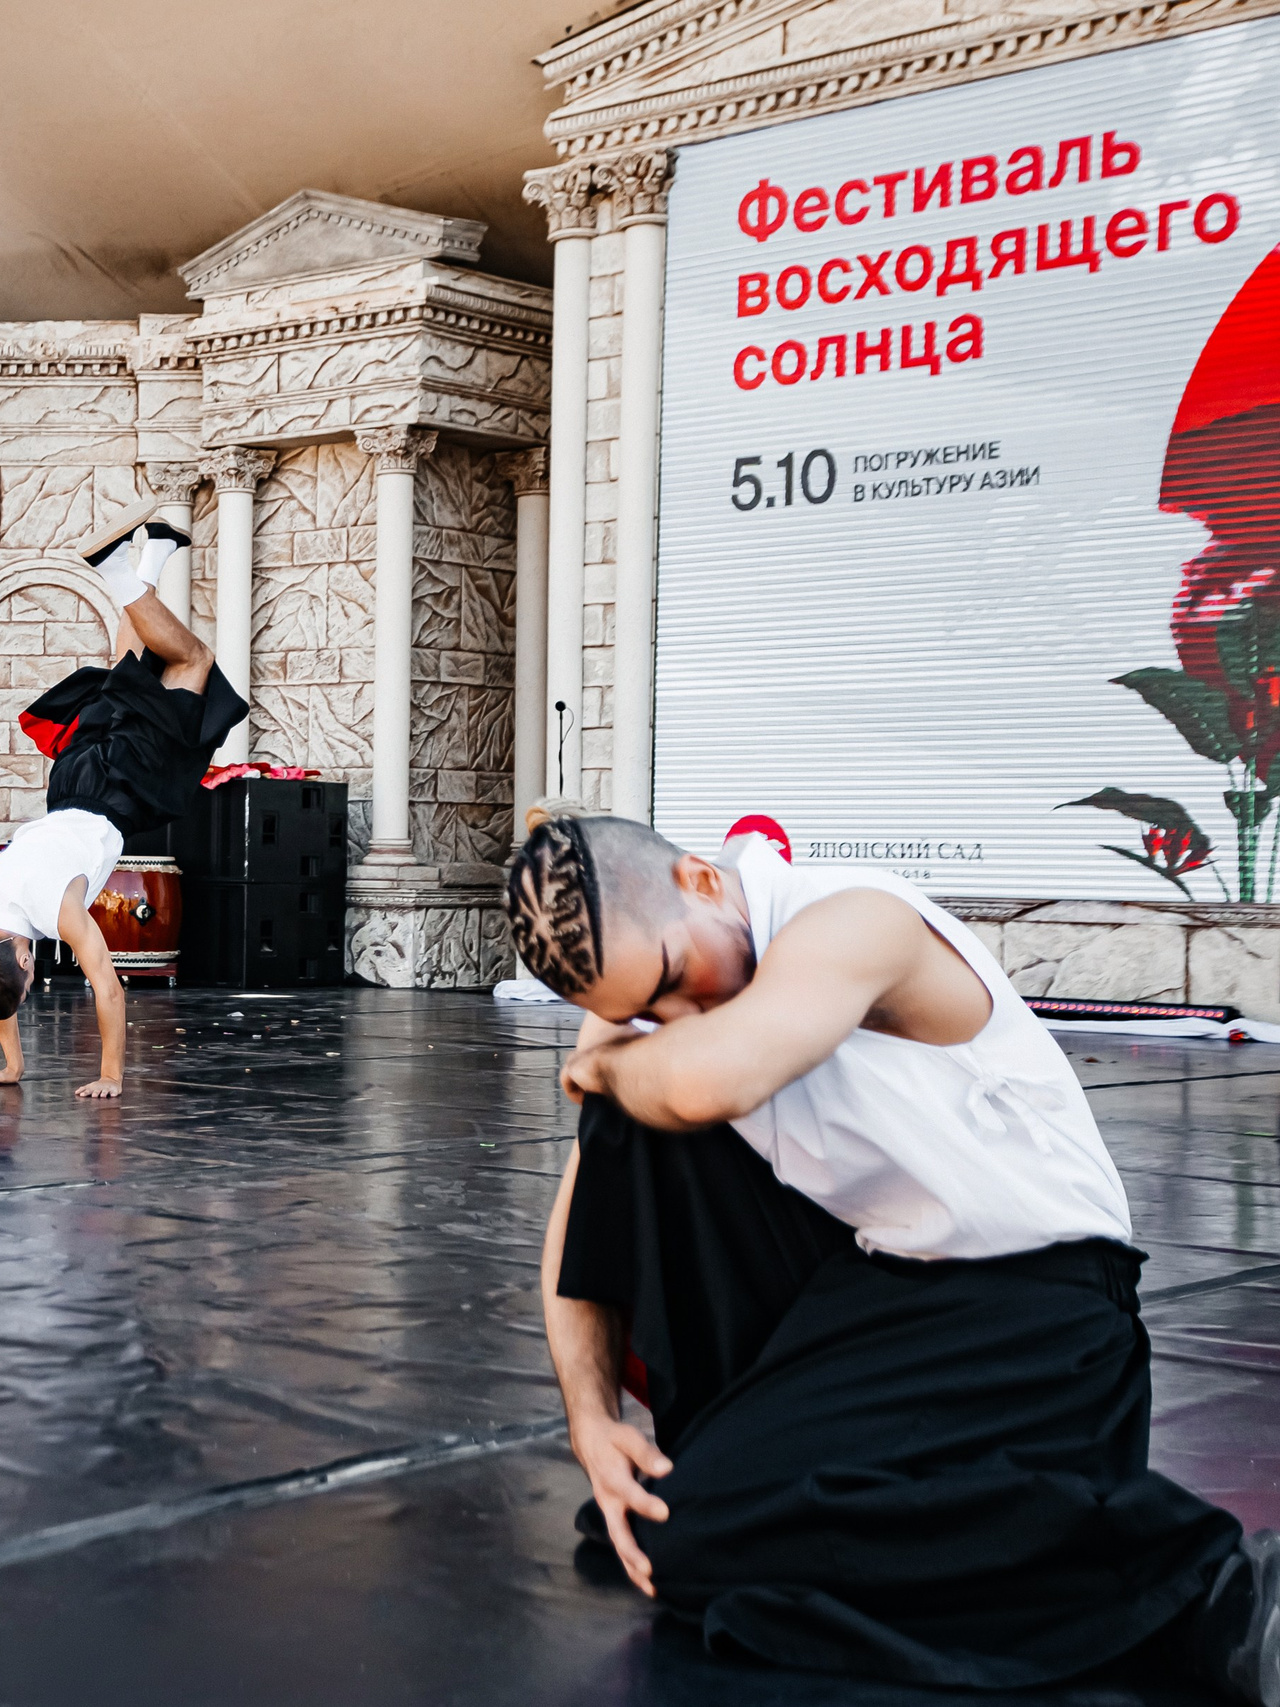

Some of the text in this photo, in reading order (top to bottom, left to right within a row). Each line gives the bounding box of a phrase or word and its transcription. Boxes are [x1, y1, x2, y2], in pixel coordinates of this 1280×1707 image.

[737, 130, 1142, 243] Фестиваль
[737, 192, 1241, 317] восходящего
[733, 312, 985, 391] солнца
[731, 448, 837, 511] 5.10
[853, 440, 1002, 474] ПОГРУЖЕНИЕ
[853, 465, 1040, 502] В КУЛЬТУРУ АЗИИ
[808, 840, 984, 861] ЯПОНСКИЙ САД
